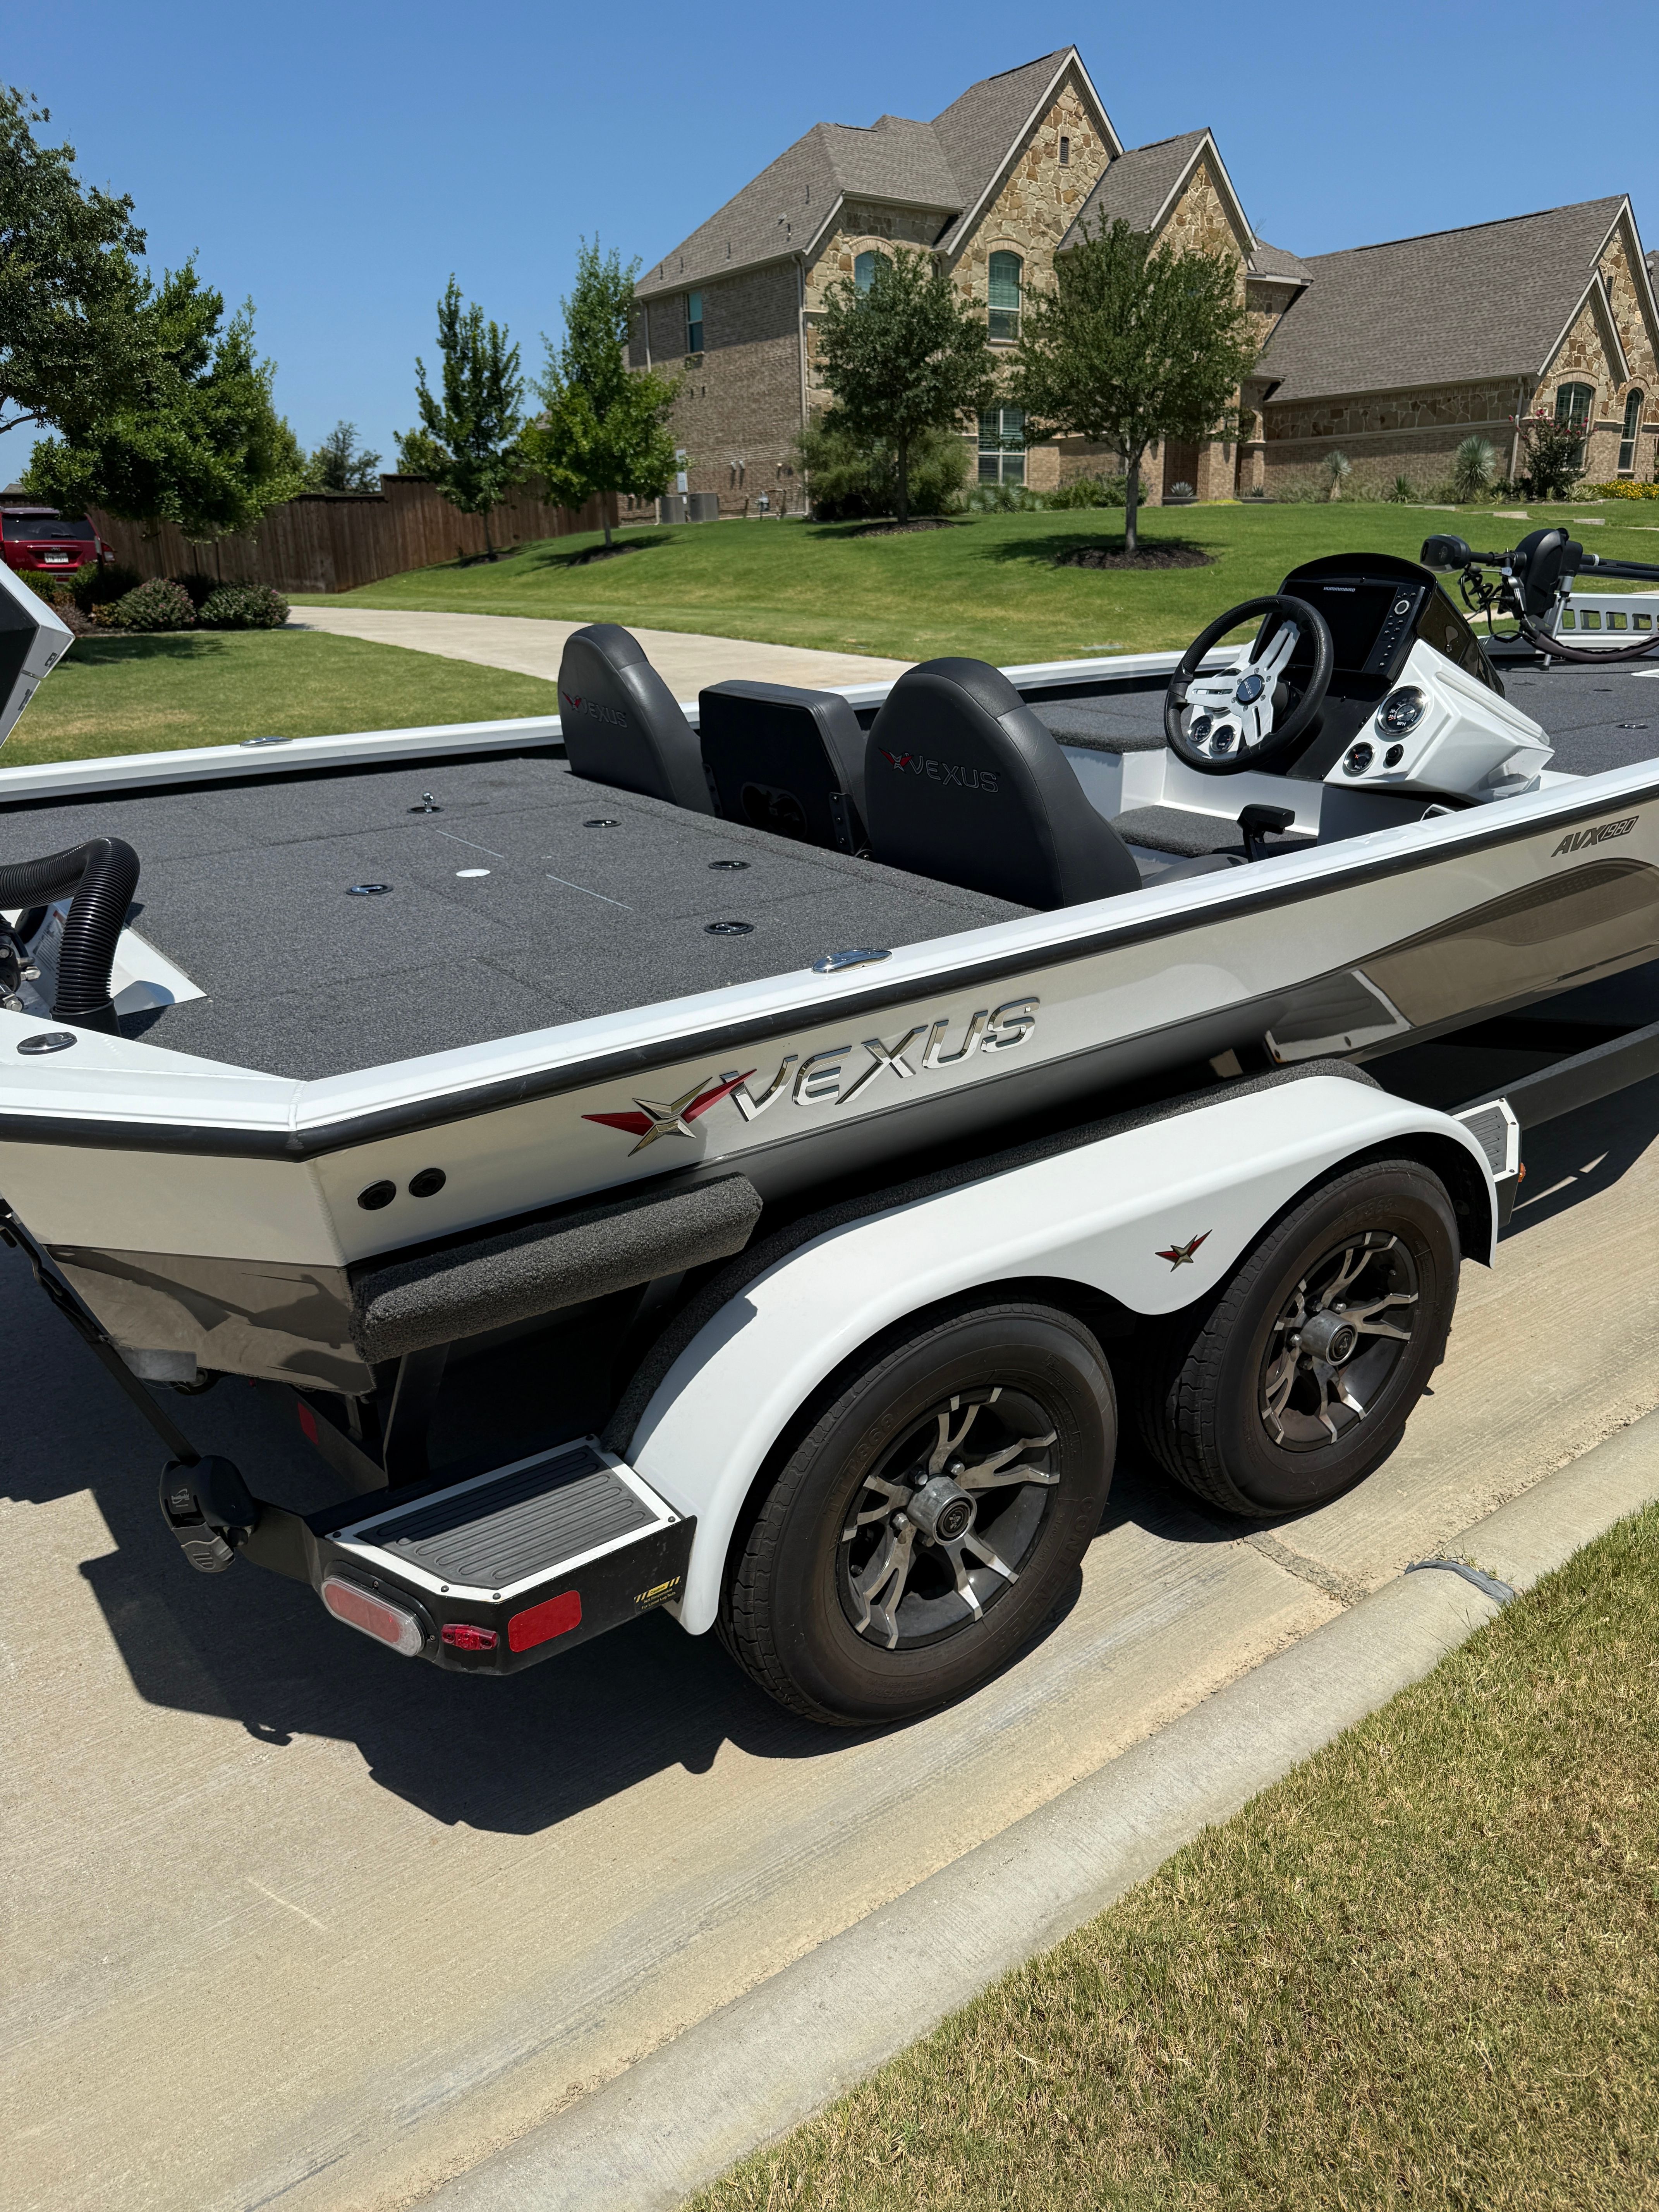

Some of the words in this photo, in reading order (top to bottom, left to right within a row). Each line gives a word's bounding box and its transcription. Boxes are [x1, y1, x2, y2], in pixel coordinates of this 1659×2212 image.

[581, 698, 628, 728] VEXUS
[905, 752, 999, 793] VEXUS
[719, 996, 1040, 1122] VEXUS
[994, 1496, 1097, 1649] CONTENDER
